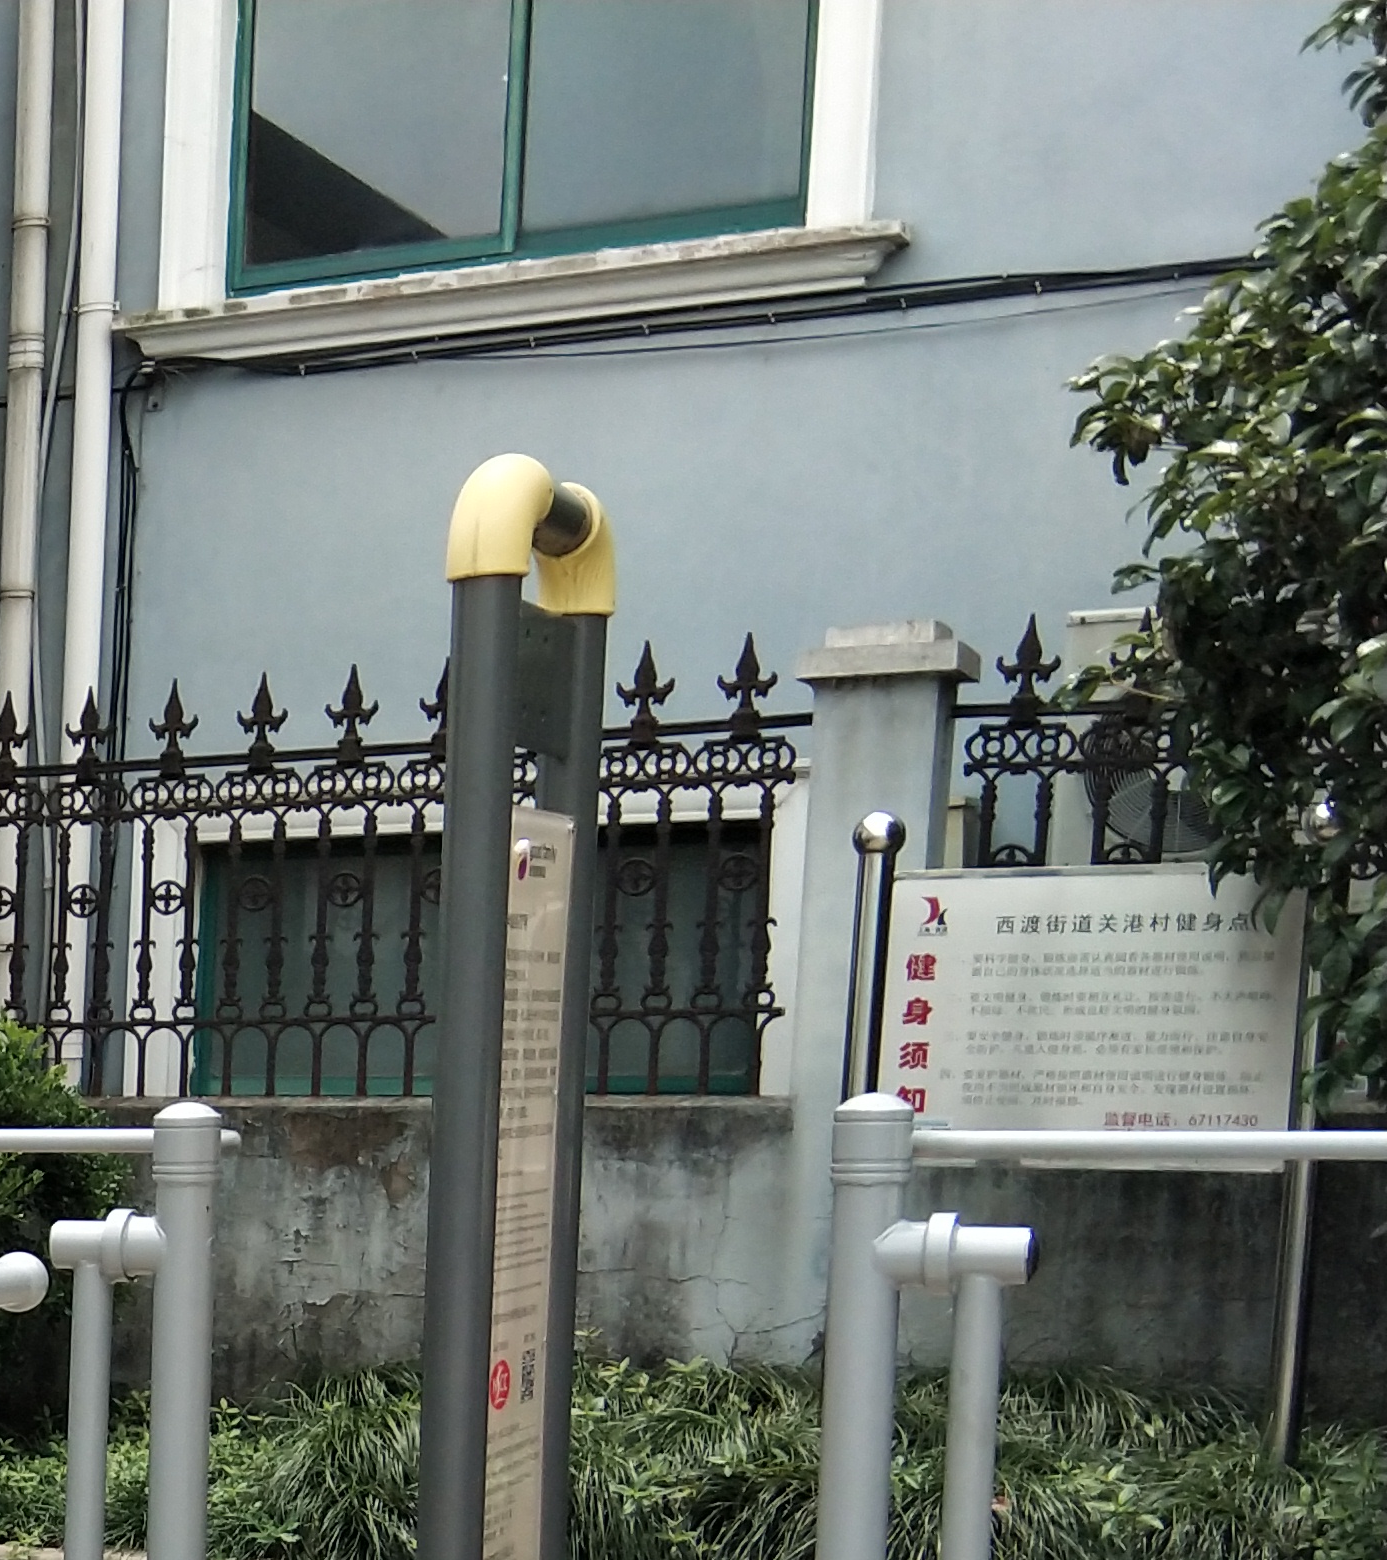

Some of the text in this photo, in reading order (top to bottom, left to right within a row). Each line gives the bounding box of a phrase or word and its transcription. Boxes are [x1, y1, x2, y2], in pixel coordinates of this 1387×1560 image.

[995, 911, 1249, 935] 西渡街道关港村健身点
[896, 953, 937, 1113] 健身须知
